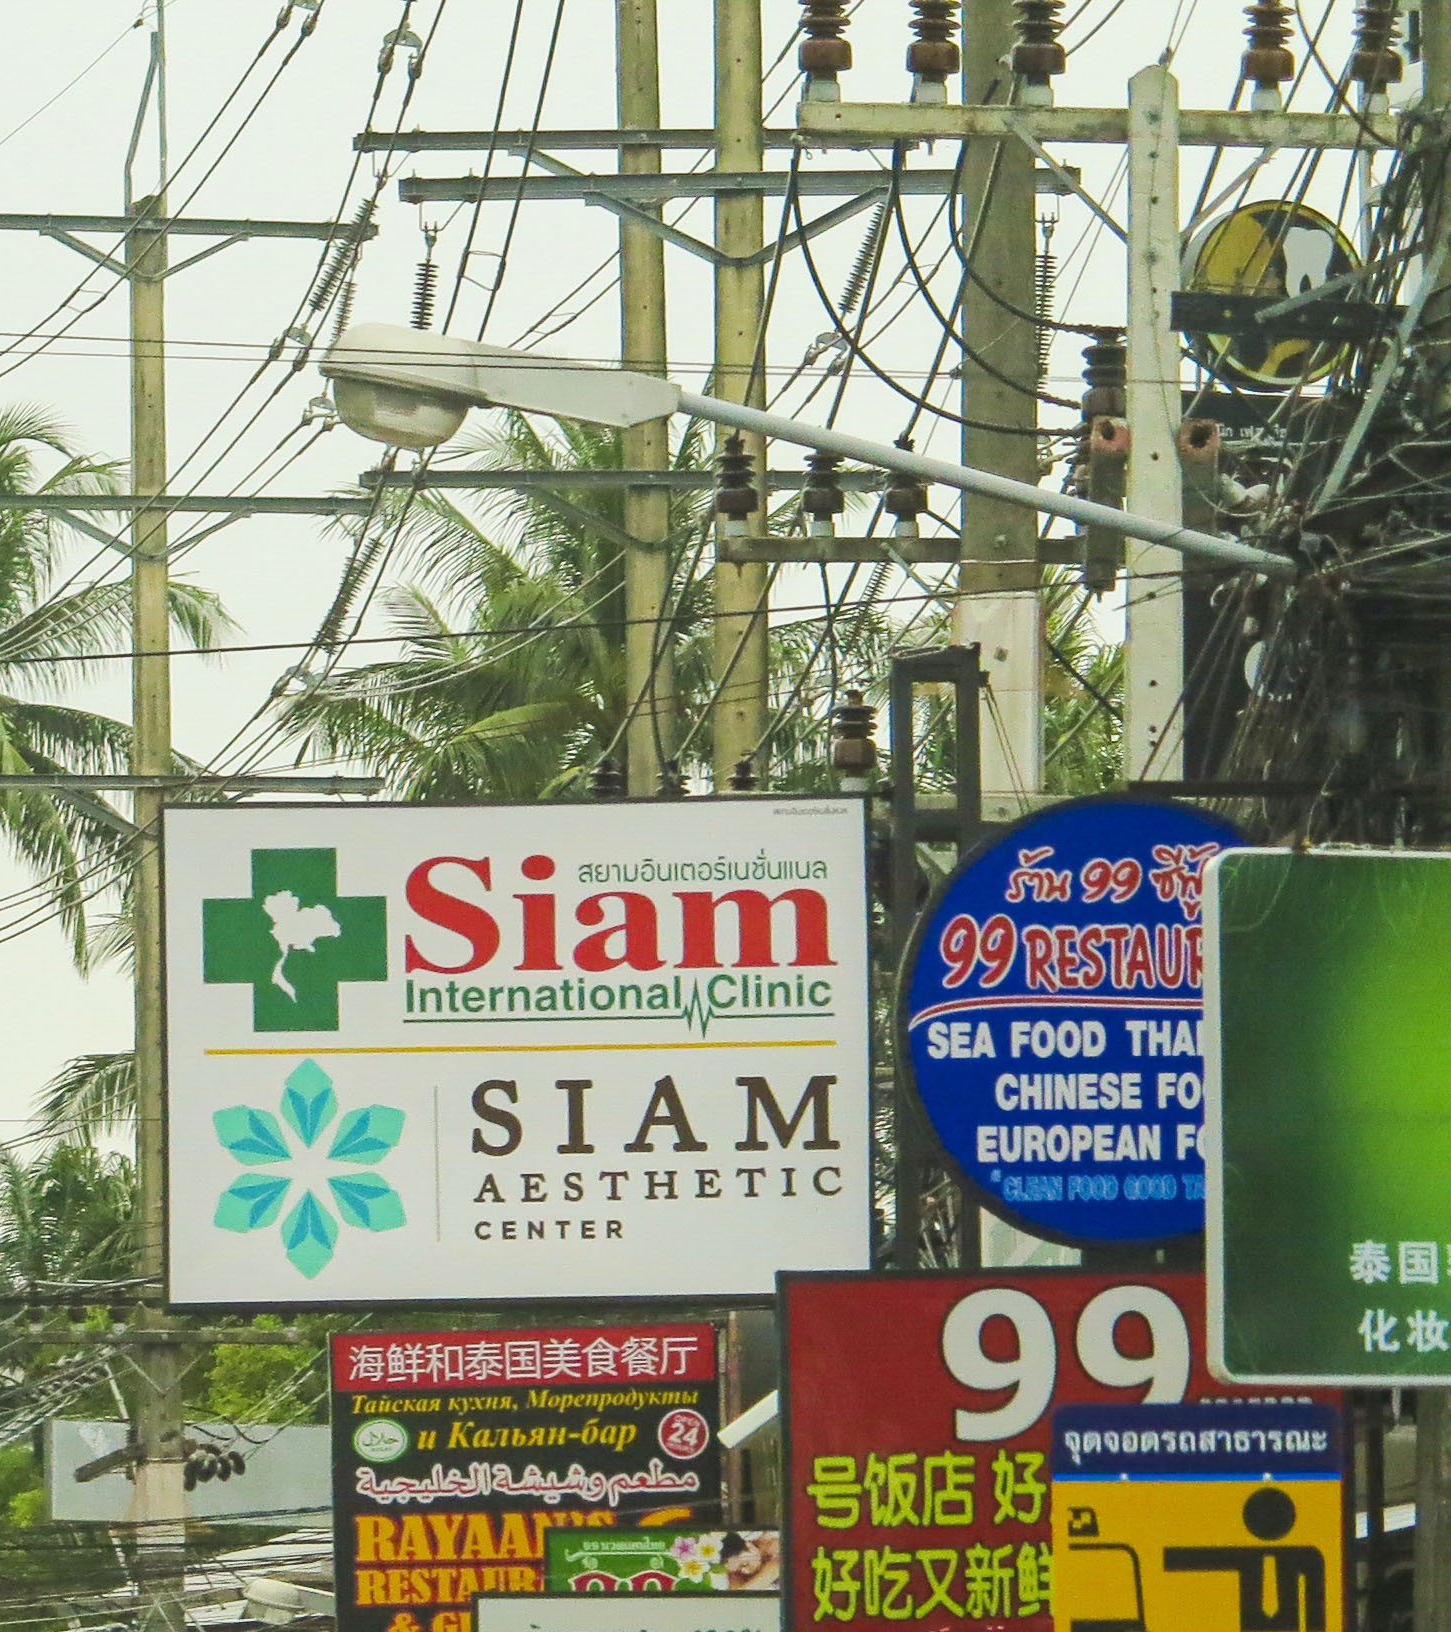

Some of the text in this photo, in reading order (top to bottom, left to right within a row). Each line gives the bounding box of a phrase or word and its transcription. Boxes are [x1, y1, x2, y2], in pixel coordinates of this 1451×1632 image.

[578, 848, 828, 883] สยามอินเตอร์เนชั่นแนล
[1080, 857, 1143, 903] 99
[404, 854, 837, 974] Siam
[940, 914, 1018, 989] 99
[405, 972, 833, 1014] International Clinic
[928, 1022, 996, 1059] SEA
[1011, 1020, 1106, 1058] FOOD
[995, 1072, 1204, 1112] CHINESE FO
[471, 1075, 841, 1156] SIAM
[977, 1124, 1161, 1163] EUROPEAN
[473, 1165, 844, 1203] AESTHETIC
[474, 1219, 624, 1241] CENTER
[1349, 1239, 1451, 1285] 泰国
[1358, 1308, 1449, 1353] 化妆
[349, 1336, 699, 1384] 海鲜和泰国美食餐厅
[941, 1284, 1191, 1443] 99
[352, 1389, 699, 1416] Тайская кухня, Морепродукты
[417, 1419, 638, 1452] и Кальян-бар
[668, 1421, 699, 1447] 24
[1064, 1429, 1328, 1466] จุดจอดรถสาธารณะ
[606, 1458, 700, 1507] مطعم
[807, 1451, 976, 1530] 号饭店
